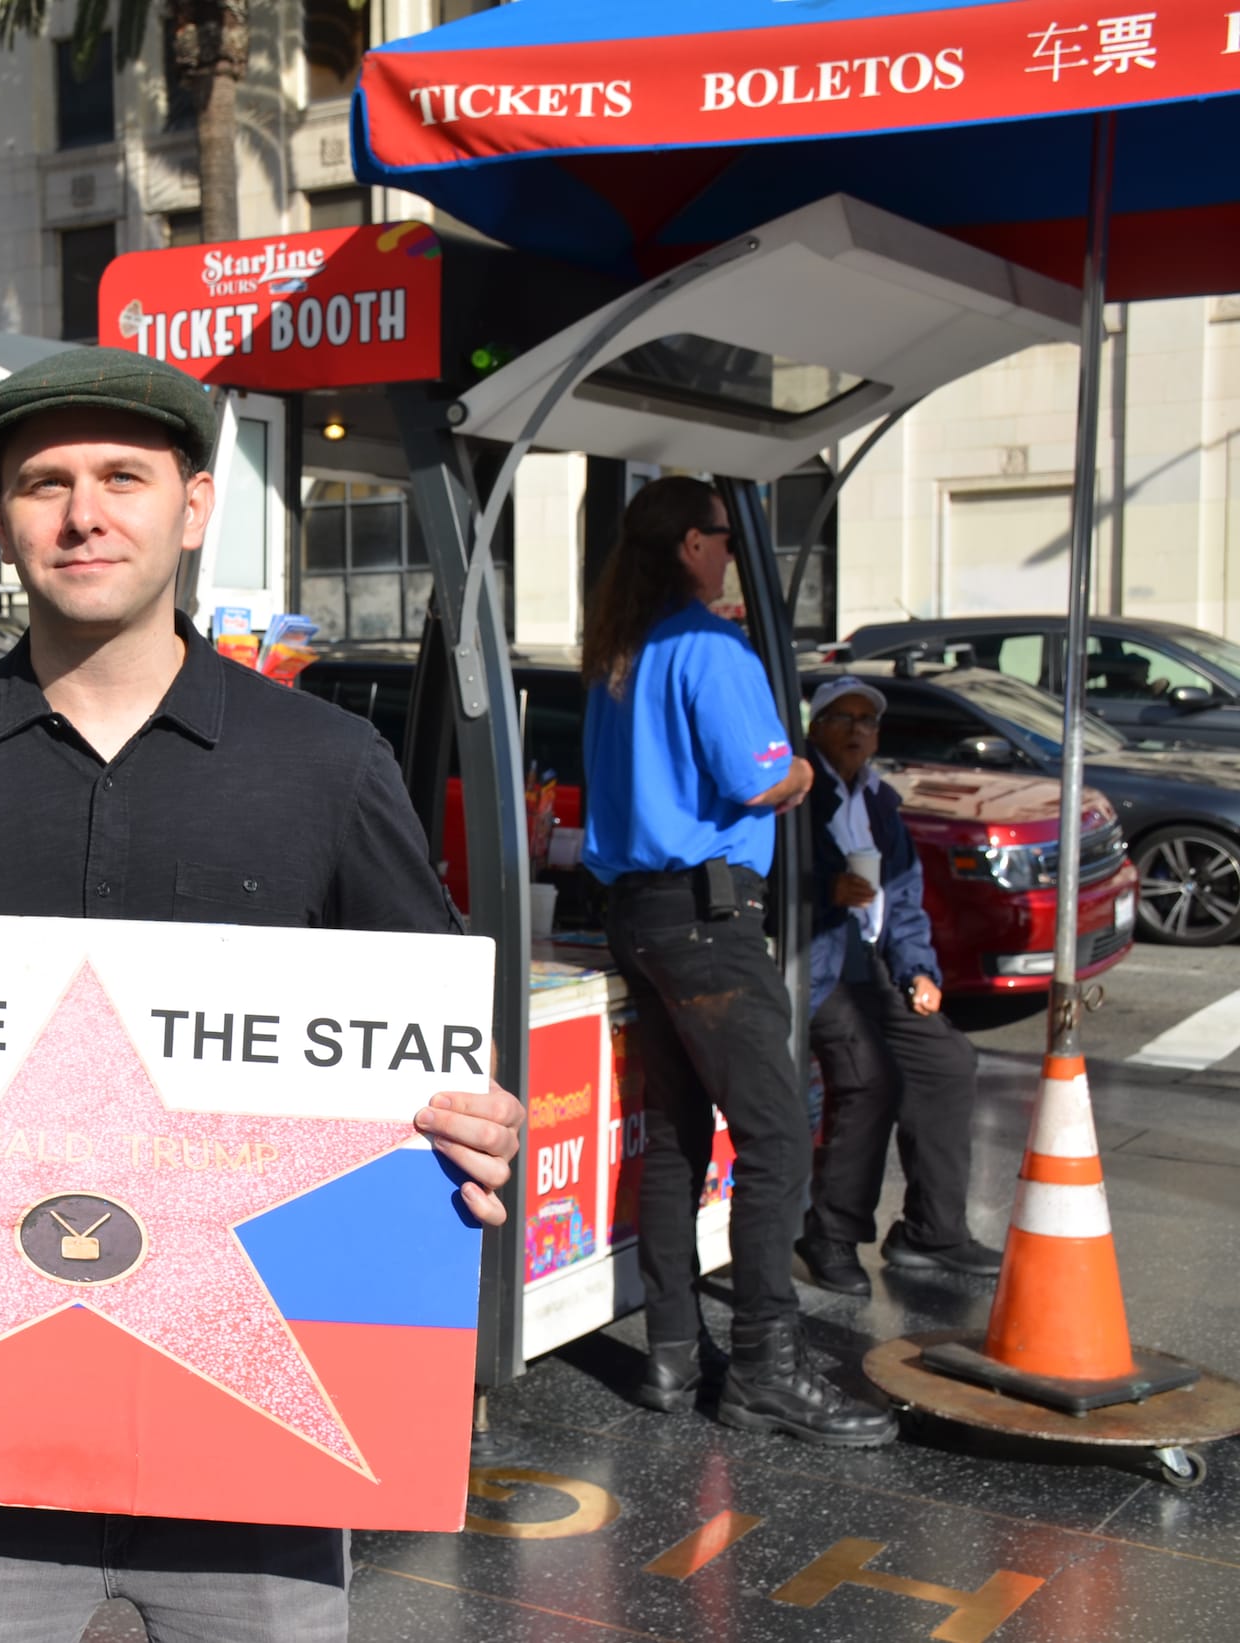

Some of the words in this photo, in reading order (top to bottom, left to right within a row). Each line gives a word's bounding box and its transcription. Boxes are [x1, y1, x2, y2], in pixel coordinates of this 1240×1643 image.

[1024, 12, 1158, 82] 车票
[410, 80, 633, 126] TICKETS
[700, 46, 965, 112] BOLETOS
[209, 279, 259, 298] TOURS
[137, 303, 259, 362] TICKET
[270, 288, 406, 351] BOOTH
[151, 1009, 280, 1064] THE
[303, 1017, 484, 1075] STAR
[122, 1133, 281, 1174] TRUMP
[537, 1136, 585, 1196] BUY
